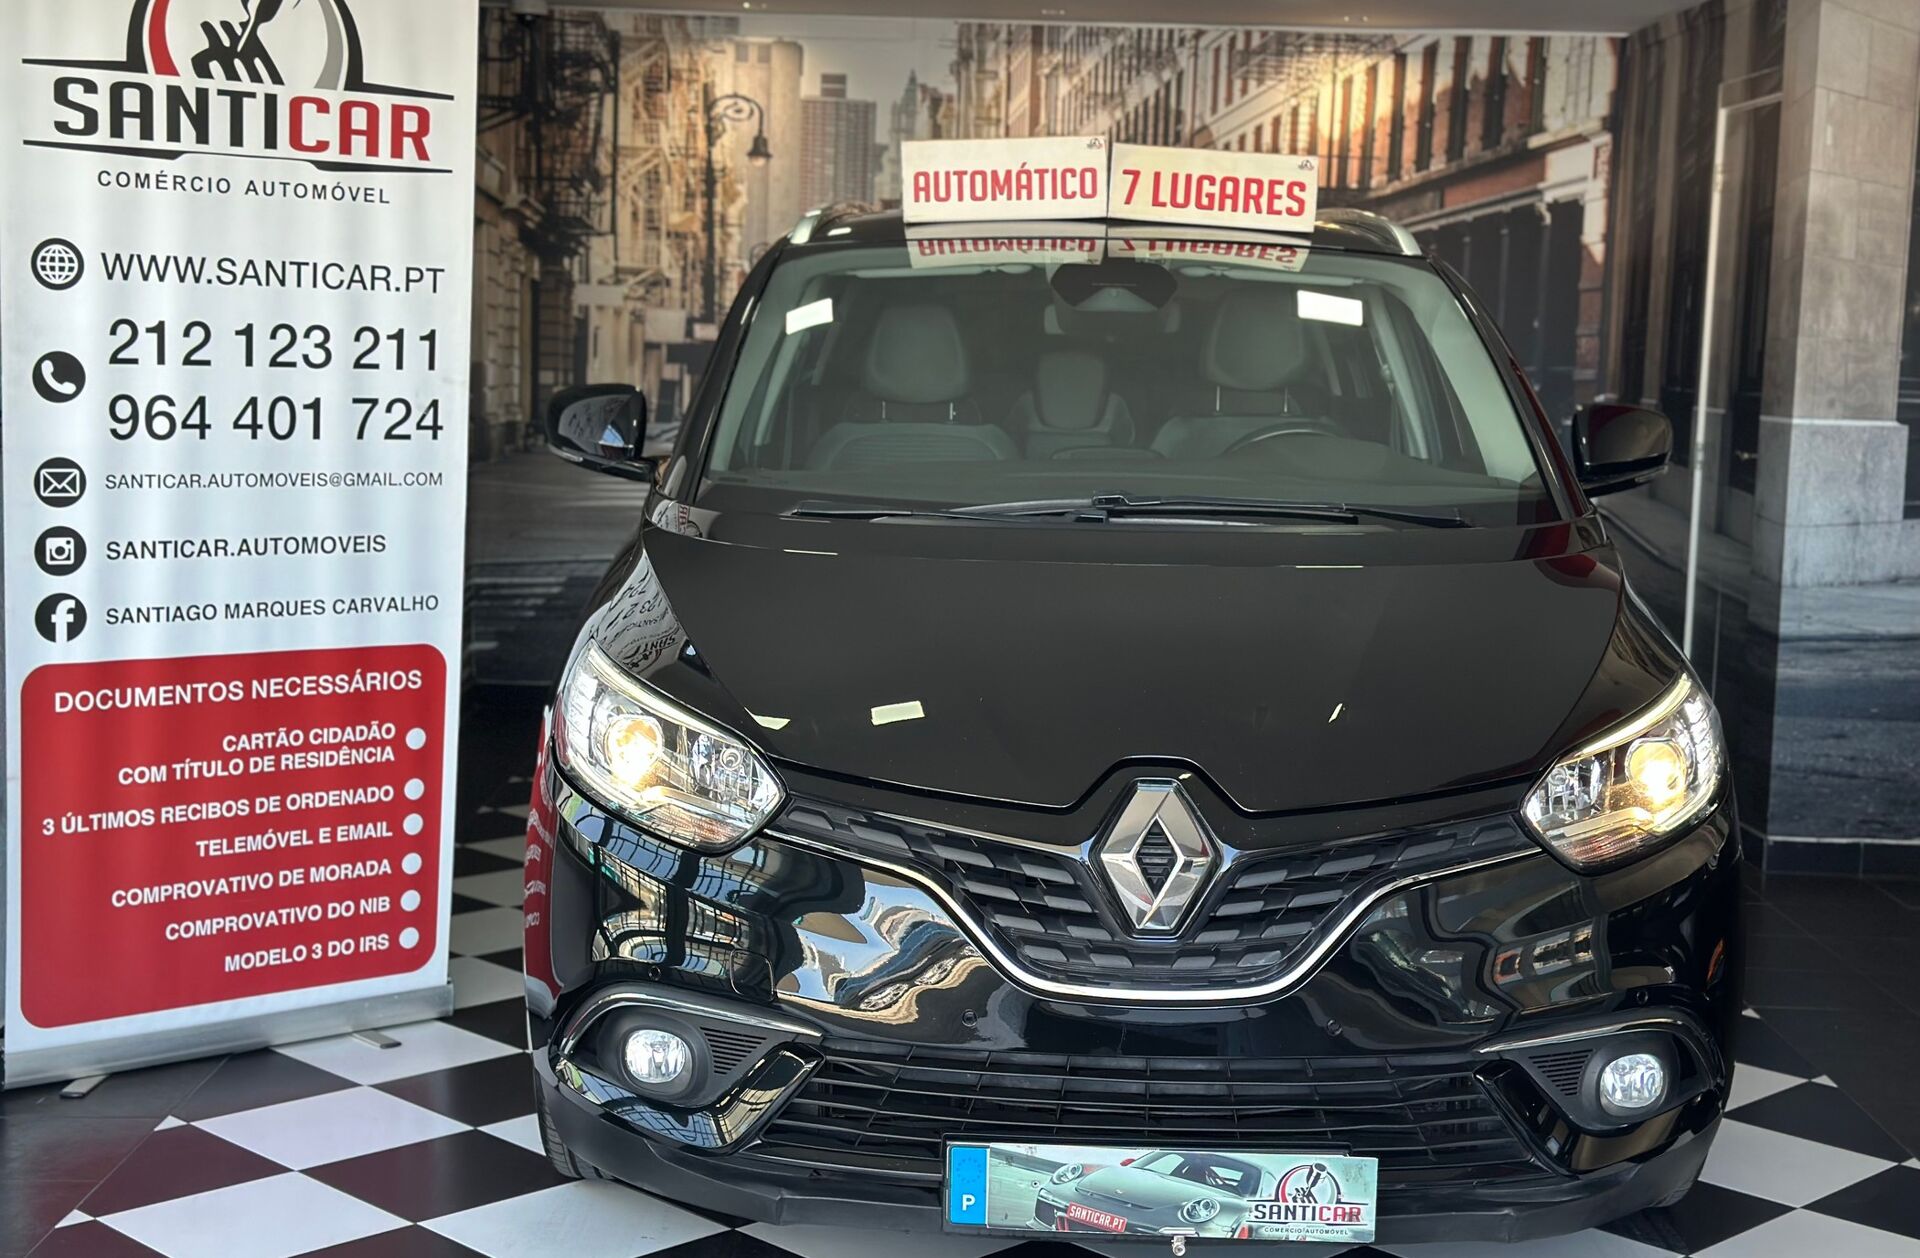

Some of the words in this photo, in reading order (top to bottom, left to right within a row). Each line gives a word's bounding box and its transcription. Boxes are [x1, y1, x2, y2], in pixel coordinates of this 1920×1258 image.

[54, 76, 430, 161] SANTICAR
[98, 171, 230, 193] COMÉRCIO
[245, 180, 389, 203] AUTOMÓVEL
[913, 162, 1098, 203] AUTOMÁTICO
[1123, 169, 1141, 204] 7
[1152, 171, 1307, 217] LUGARES
[101, 253, 444, 293] WWW.SANTICAR.PT
[109, 319, 211, 366] 212
[235, 323, 331, 369] 123
[353, 326, 436, 370] 211
[109, 394, 211, 440] 964
[233, 396, 320, 440] 401
[352, 398, 443, 440] 724
[106, 473, 442, 489] SANTICAR.AUTOMOVEIS@GMAIL.COM
[107, 535, 385, 560] SANTICAR.AUTOMOVEIS
[107, 604, 217, 624] SANTIAGO
[225, 600, 325, 619] MARQUES
[333, 595, 438, 614] CARVALHO
[55, 681, 243, 712] DOCUMENTOS
[252, 669, 422, 699] NECESSÁRIOS
[223, 728, 304, 752] CARTÃO
[309, 721, 395, 744] CIDADÃO
[119, 765, 167, 785] COM
[172, 758, 244, 780] TÍTULO
[250, 755, 275, 773] DE
[281, 746, 394, 770] RESIDÊNCIA
[43, 818, 55, 835] 3
[61, 808, 155, 833] ÚLTIMOS
[161, 799, 249, 824] RECIBOS
[255, 796, 281, 814] DE
[286, 785, 394, 810] ORDENADO
[196, 829, 313, 857] TELEMÓVEL
[319, 827, 331, 843] E
[337, 821, 392, 842] EMAIL
[112, 872, 273, 907] COMPROVATIVO
[279, 868, 304, 886] DE
[310, 859, 391, 883] MORADA
[166, 905, 322, 940] COMPROVATIVO
[328, 901, 355, 919] DO
[360, 896, 390, 914] NIB
[225, 945, 307, 972] MODELO
[312, 943, 322, 959] 3
[328, 939, 355, 957] DO
[360, 934, 389, 952] IRS
[962, 1194, 976, 1211] P
[1069, 1205, 1124, 1231] SANTICAR.PT
[1254, 1204, 1361, 1222] SANTICAR
